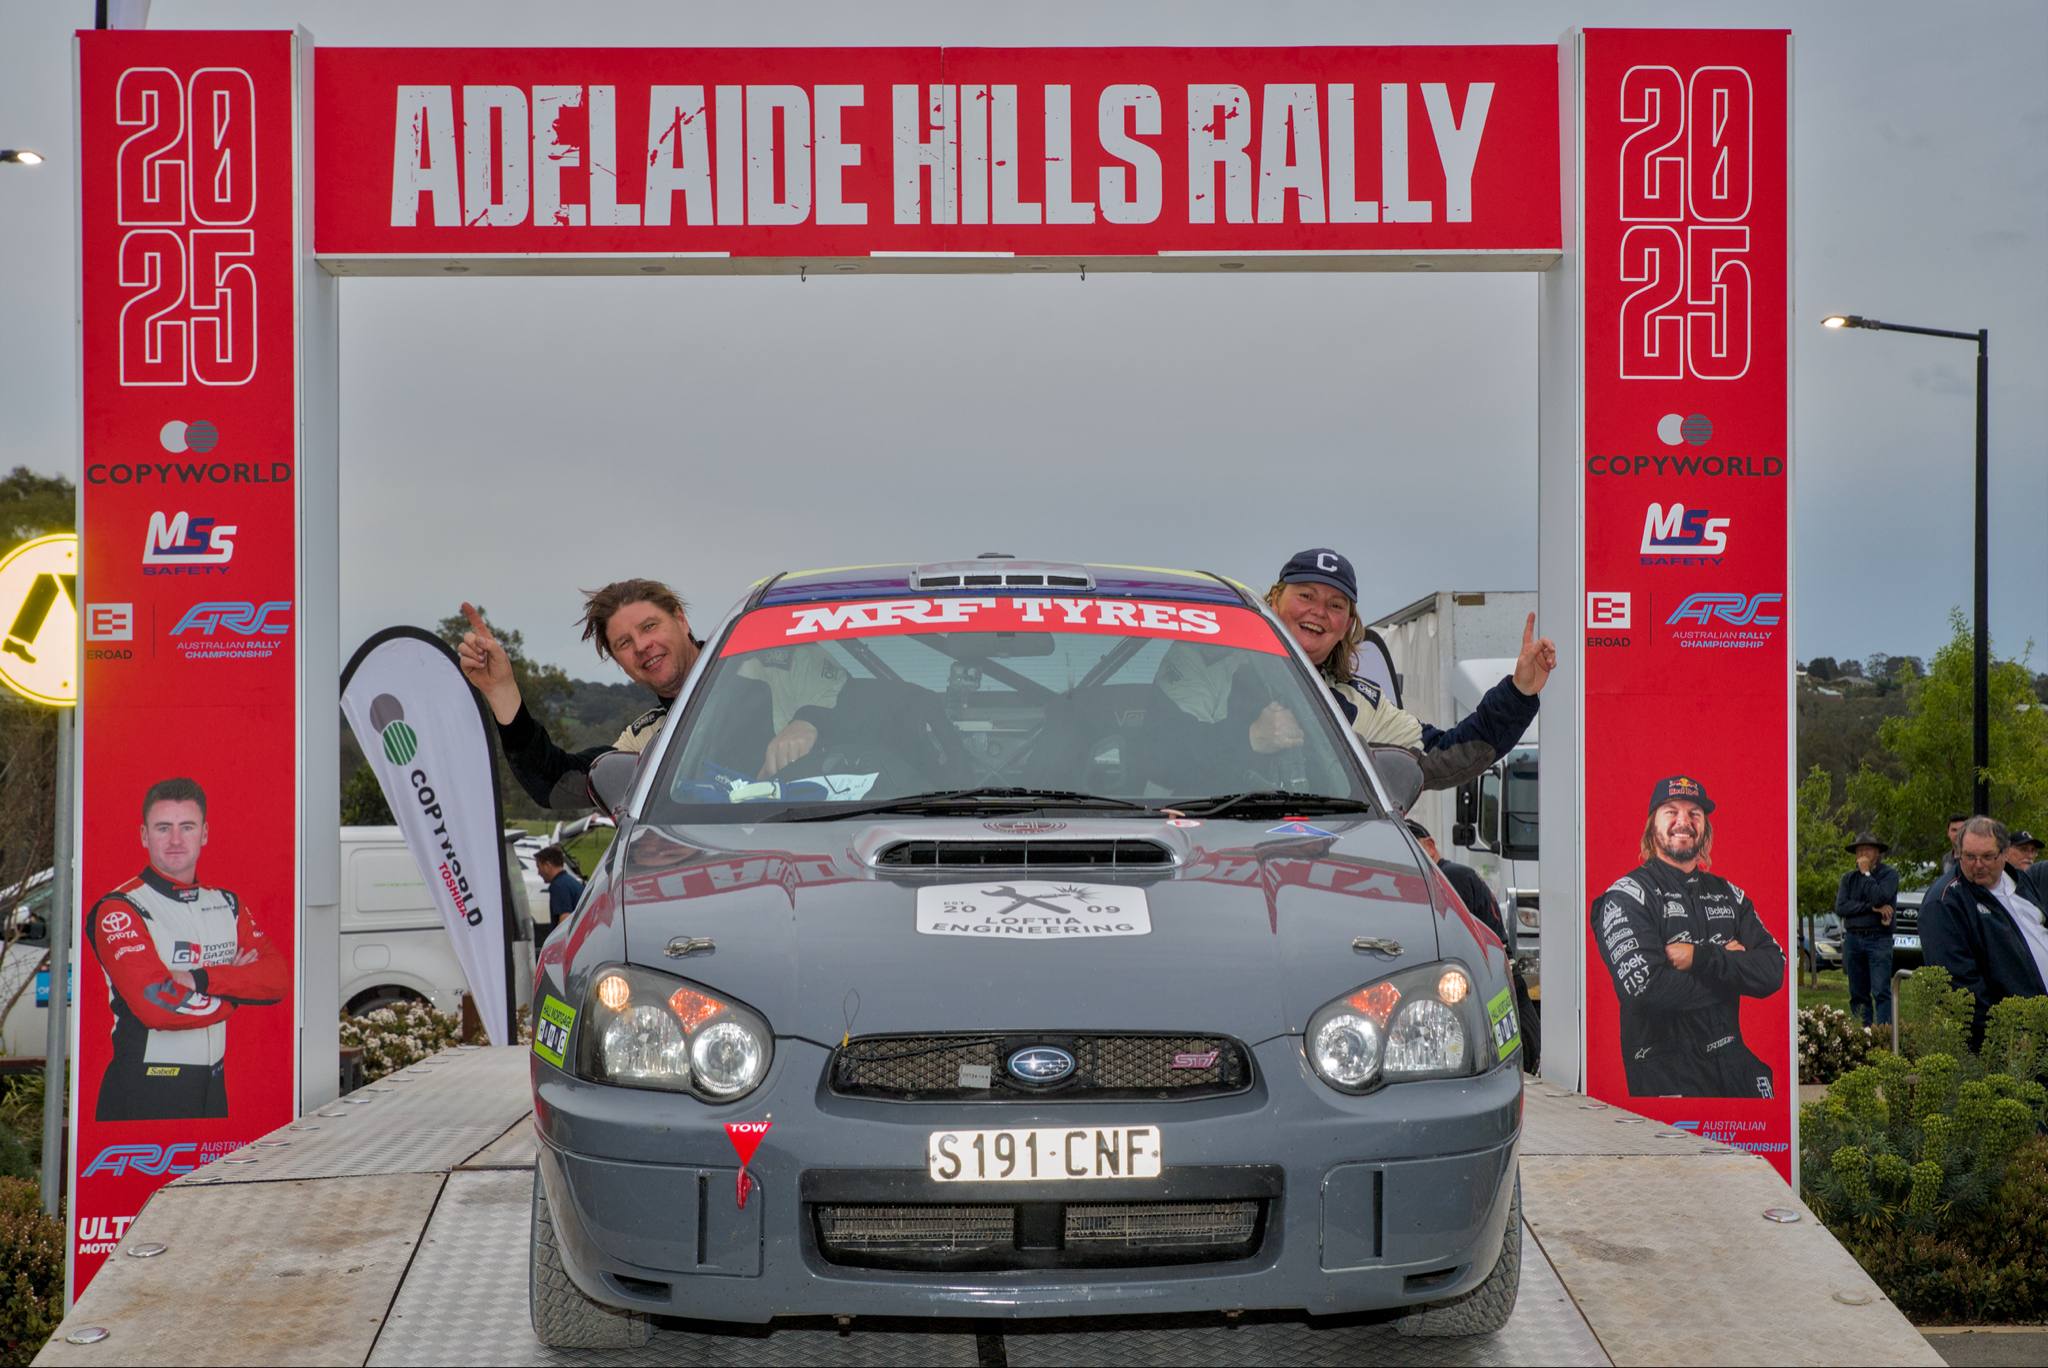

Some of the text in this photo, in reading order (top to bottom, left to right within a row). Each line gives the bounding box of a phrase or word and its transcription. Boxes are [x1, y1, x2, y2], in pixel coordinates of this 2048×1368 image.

[116, 67, 256, 225] 20
[1620, 65, 1753, 222] 20
[390, 82, 1496, 226] ADELAIDE HILLS RALLY
[118, 229, 257, 386] 25
[1620, 225, 1751, 380] 25
[1588, 455, 1784, 476] COPYWORLD
[87, 463, 291, 484] COPYWORLD
[1316, 553, 1339, 573] C
[1640, 557, 1725, 566] SAFETY
[142, 566, 231, 575] SAFETY
[1665, 592, 1783, 626] ARC
[169, 601, 292, 635] ARC
[785, 597, 1221, 636] MRF TYRES
[1672, 631, 1772, 640] AUSTRALIAN RALLY
[177, 640, 281, 650] AUSTRALIAN RALLY
[1587, 637, 1631, 647] EROAD
[1680, 640, 1764, 648] CHAMPIONSHIP
[87, 650, 133, 660] EROAD
[185, 650, 273, 659] CHAMPIONSHIP
[438, 862, 467, 918] TOSHIBA
[944, 905, 977, 913] 20
[1087, 905, 1120, 913] 09
[985, 917, 1082, 925] LOFTIA
[932, 923, 1134, 933] ENGINEERING
[106, 930, 138, 944] TOYOTA
[1623, 965, 1650, 995] FIST
[729, 1123, 768, 1133] TOW
[1703, 1121, 1767, 1131] AUSTRALIAN
[1703, 1131, 1737, 1141] RALLY
[81, 1143, 197, 1177] ARC
[79, 1216, 136, 1240] ULT
[79, 1243, 117, 1254] MOTO
